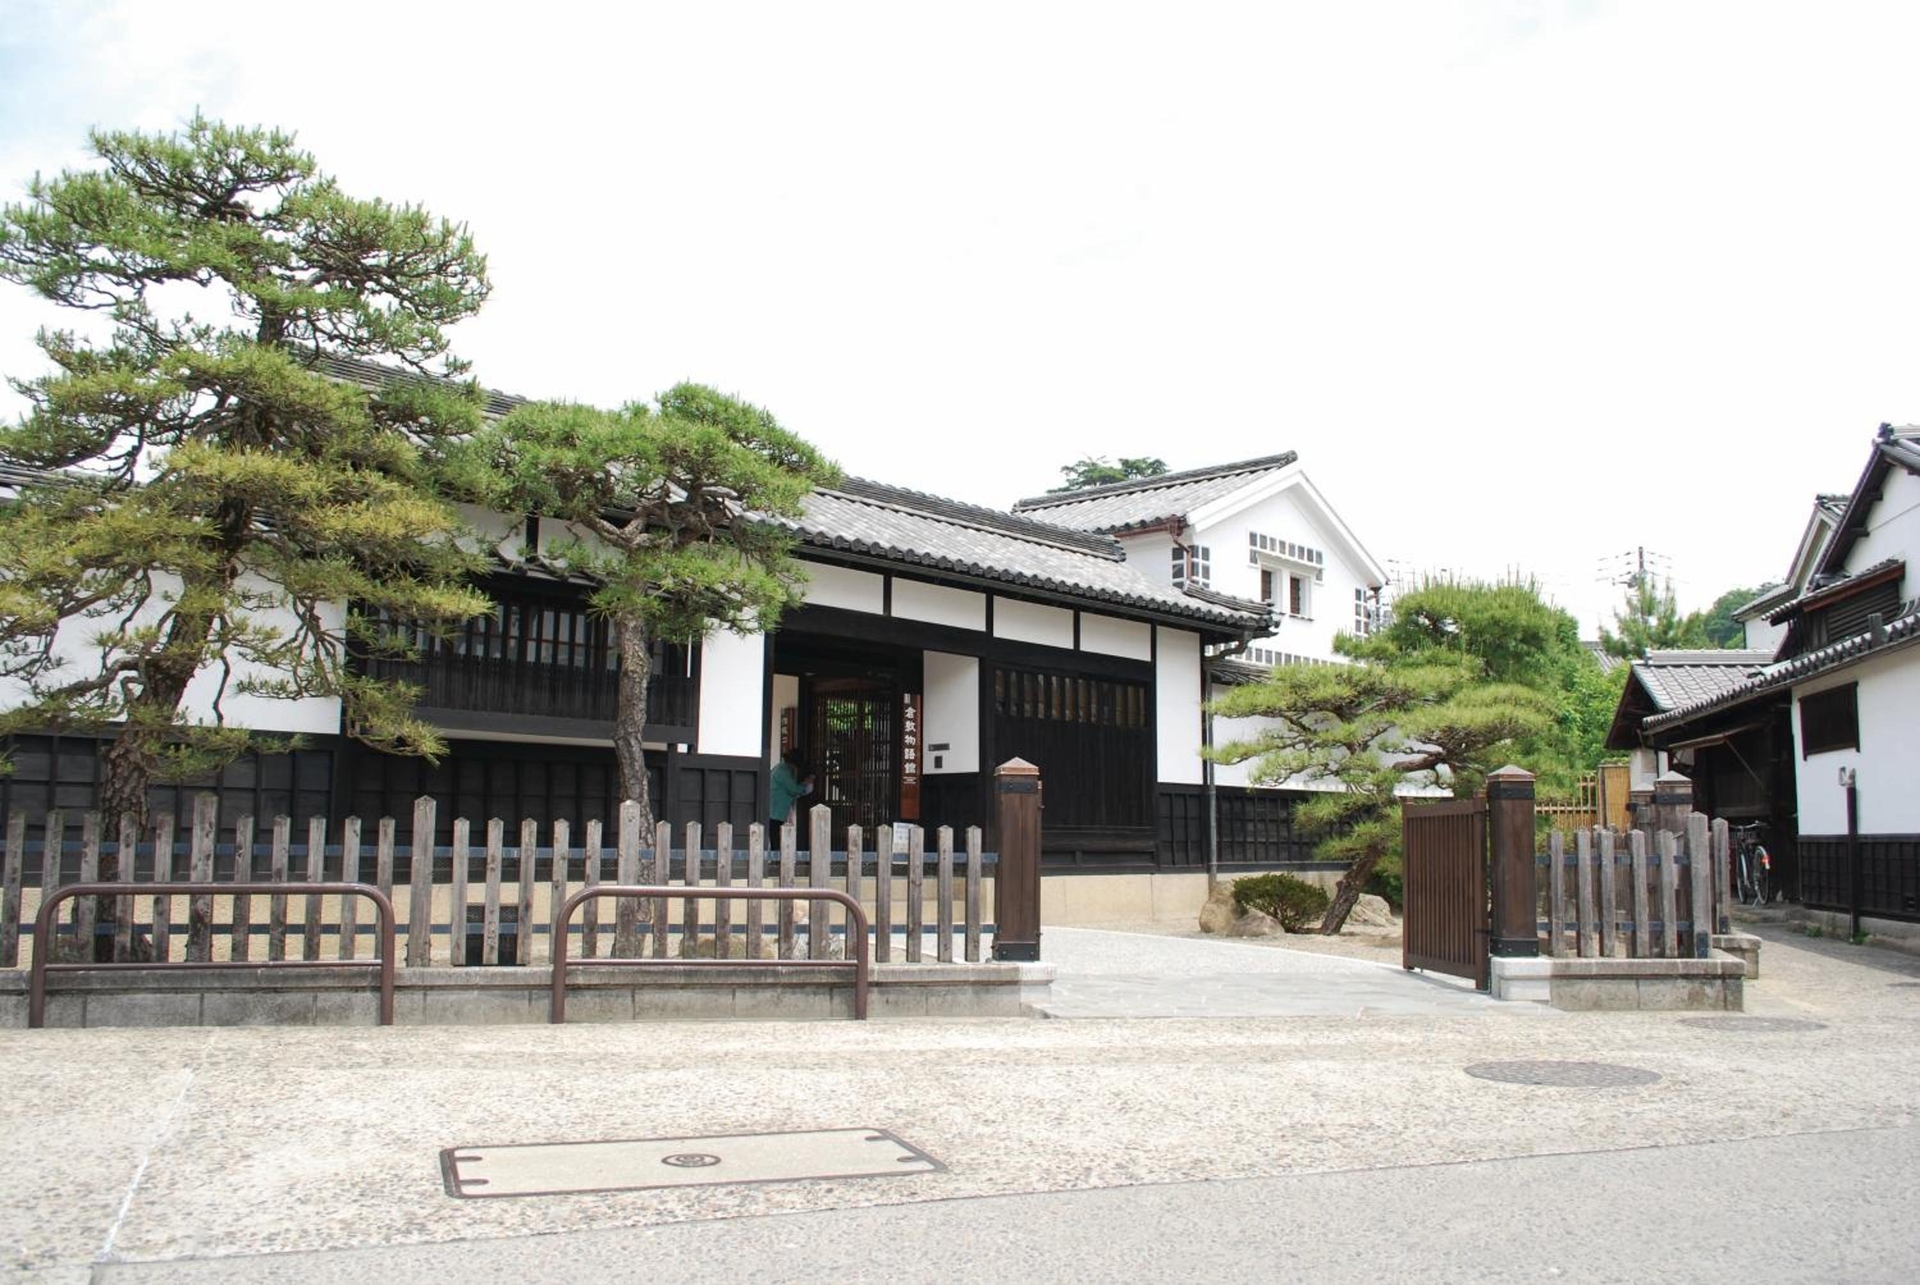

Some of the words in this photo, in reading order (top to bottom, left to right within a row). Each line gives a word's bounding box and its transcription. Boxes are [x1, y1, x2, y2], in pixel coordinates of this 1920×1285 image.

[904, 706, 916, 774] 倉敷物語館
